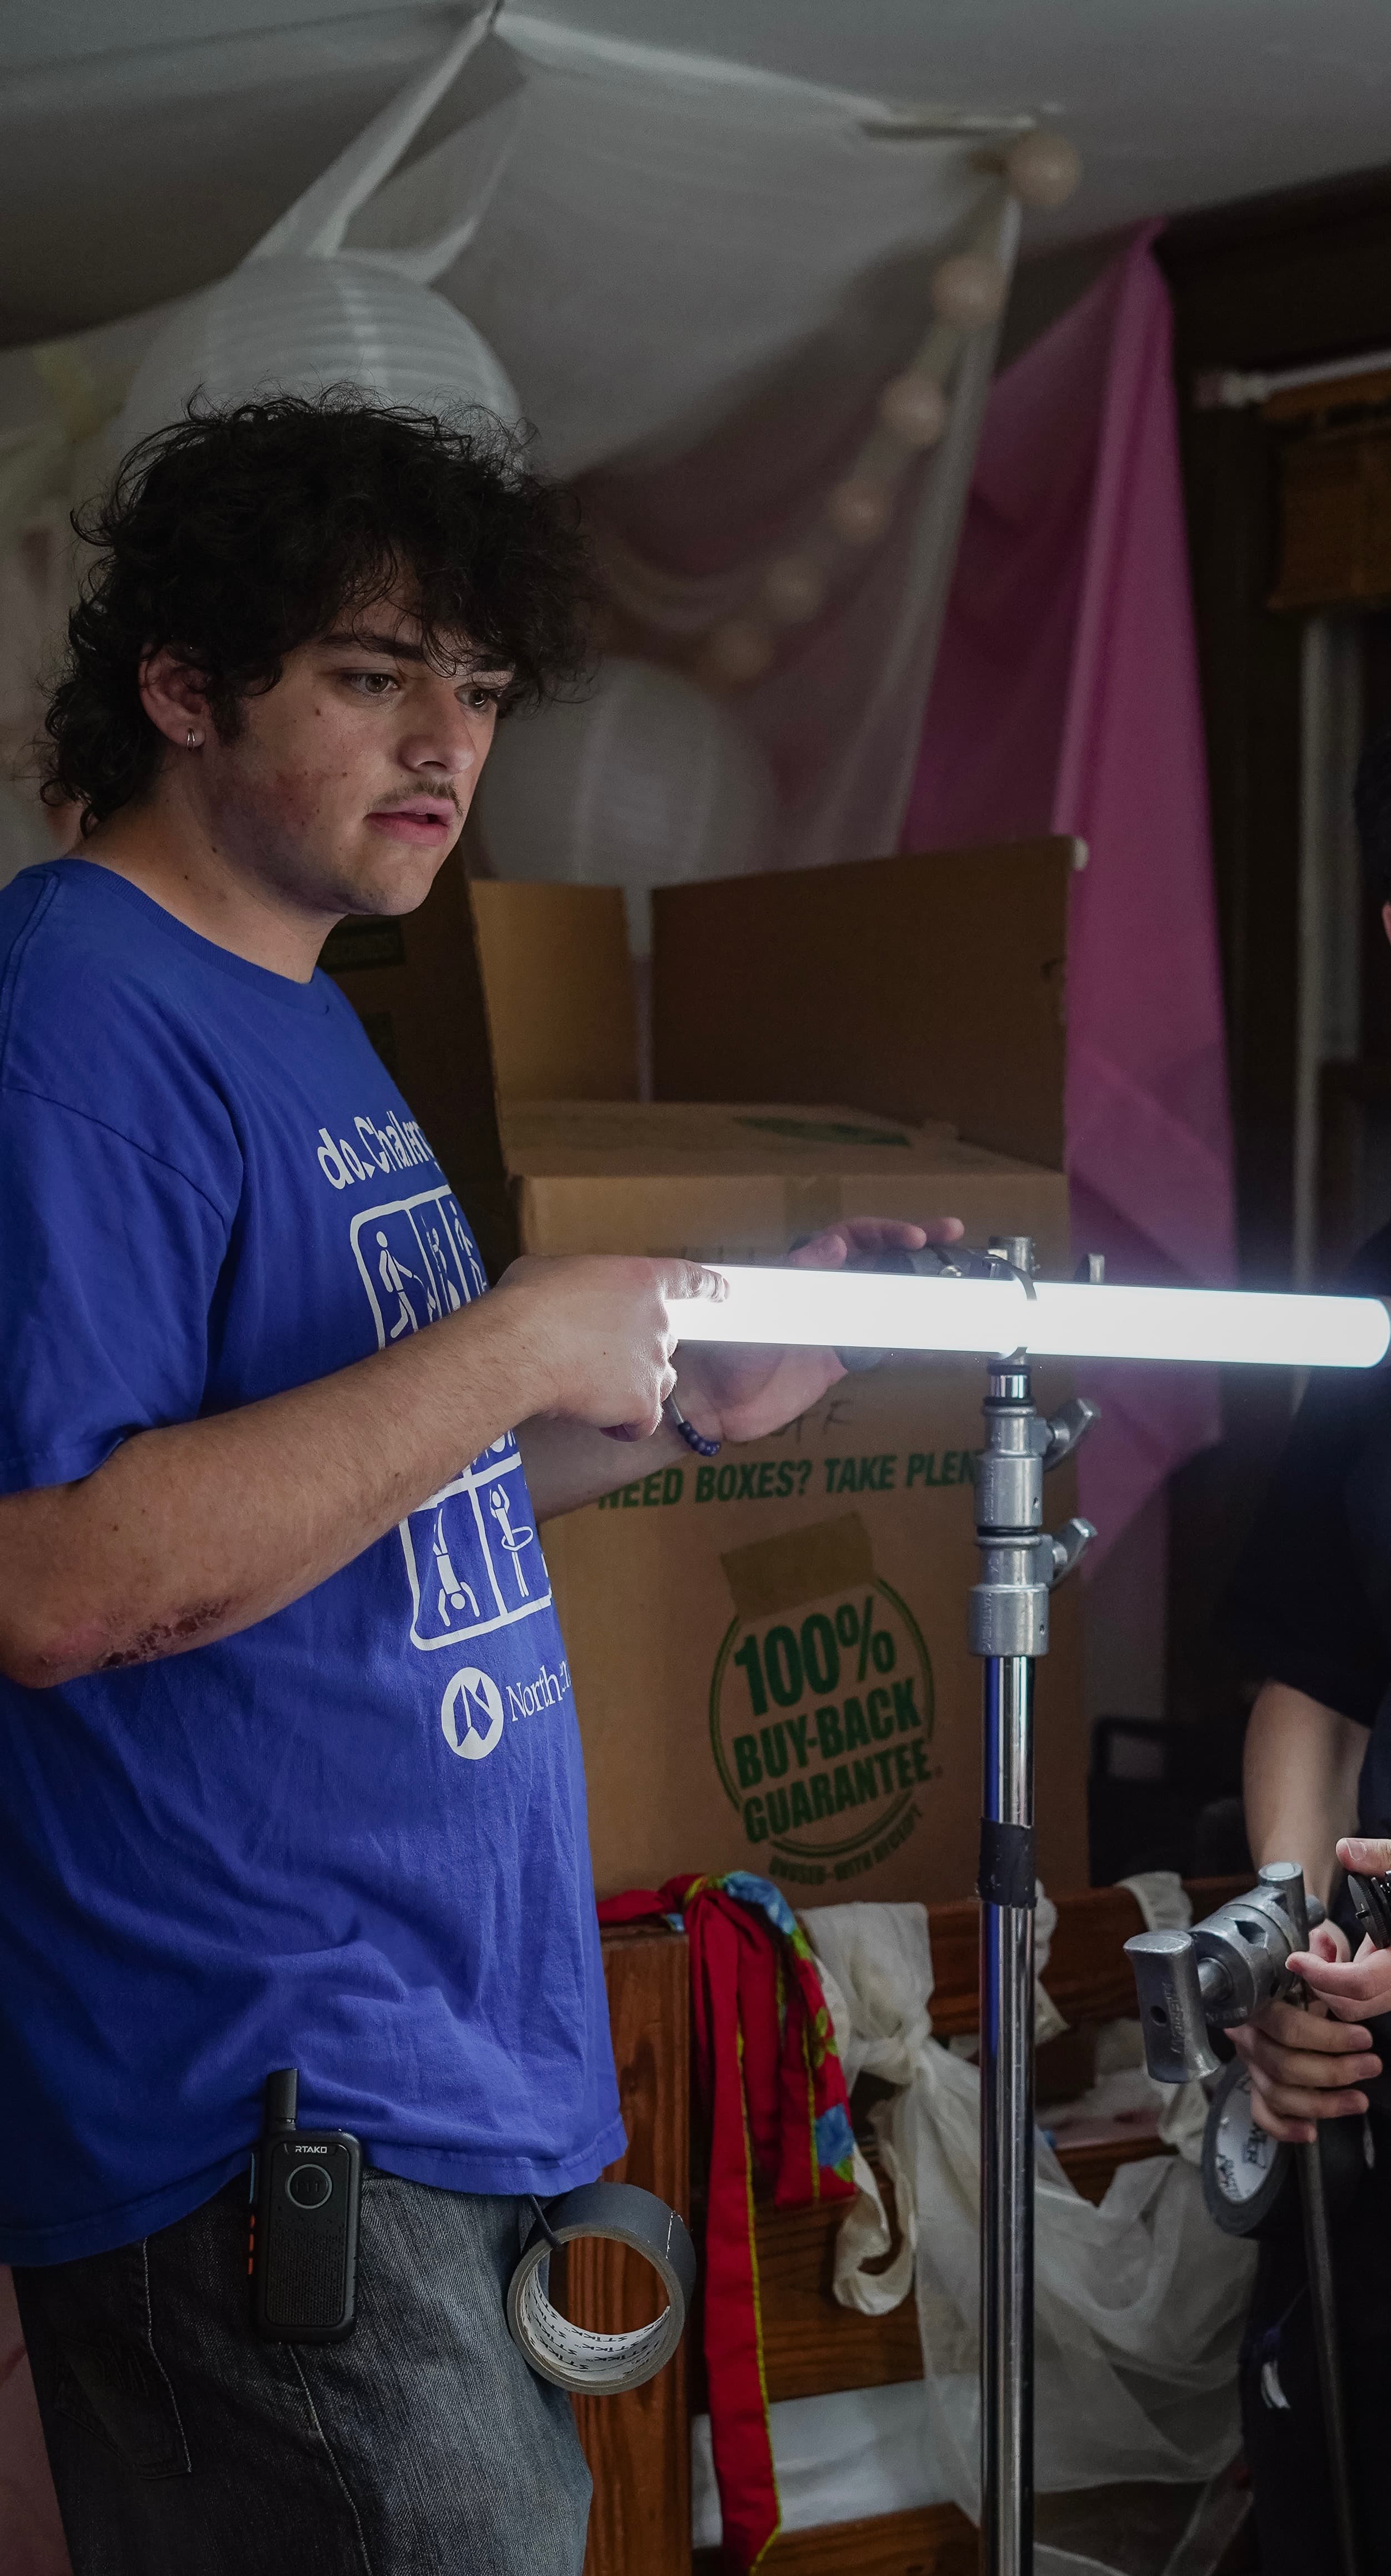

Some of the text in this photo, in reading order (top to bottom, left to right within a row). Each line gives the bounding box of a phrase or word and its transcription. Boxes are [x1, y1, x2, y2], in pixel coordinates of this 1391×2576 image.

[694, 1459, 812, 1504] BOXES?
[824, 1455, 895, 1494] TAKE
[906, 1451, 979, 1487] PLEN
[734, 1595, 897, 1716] 100%
[733, 1677, 922, 1790] BUY-BACK
[742, 1738, 933, 1844] GUARANTEE
[571, 2327, 628, 2343] STIKK
[582, 2341, 639, 2353] STIKK
